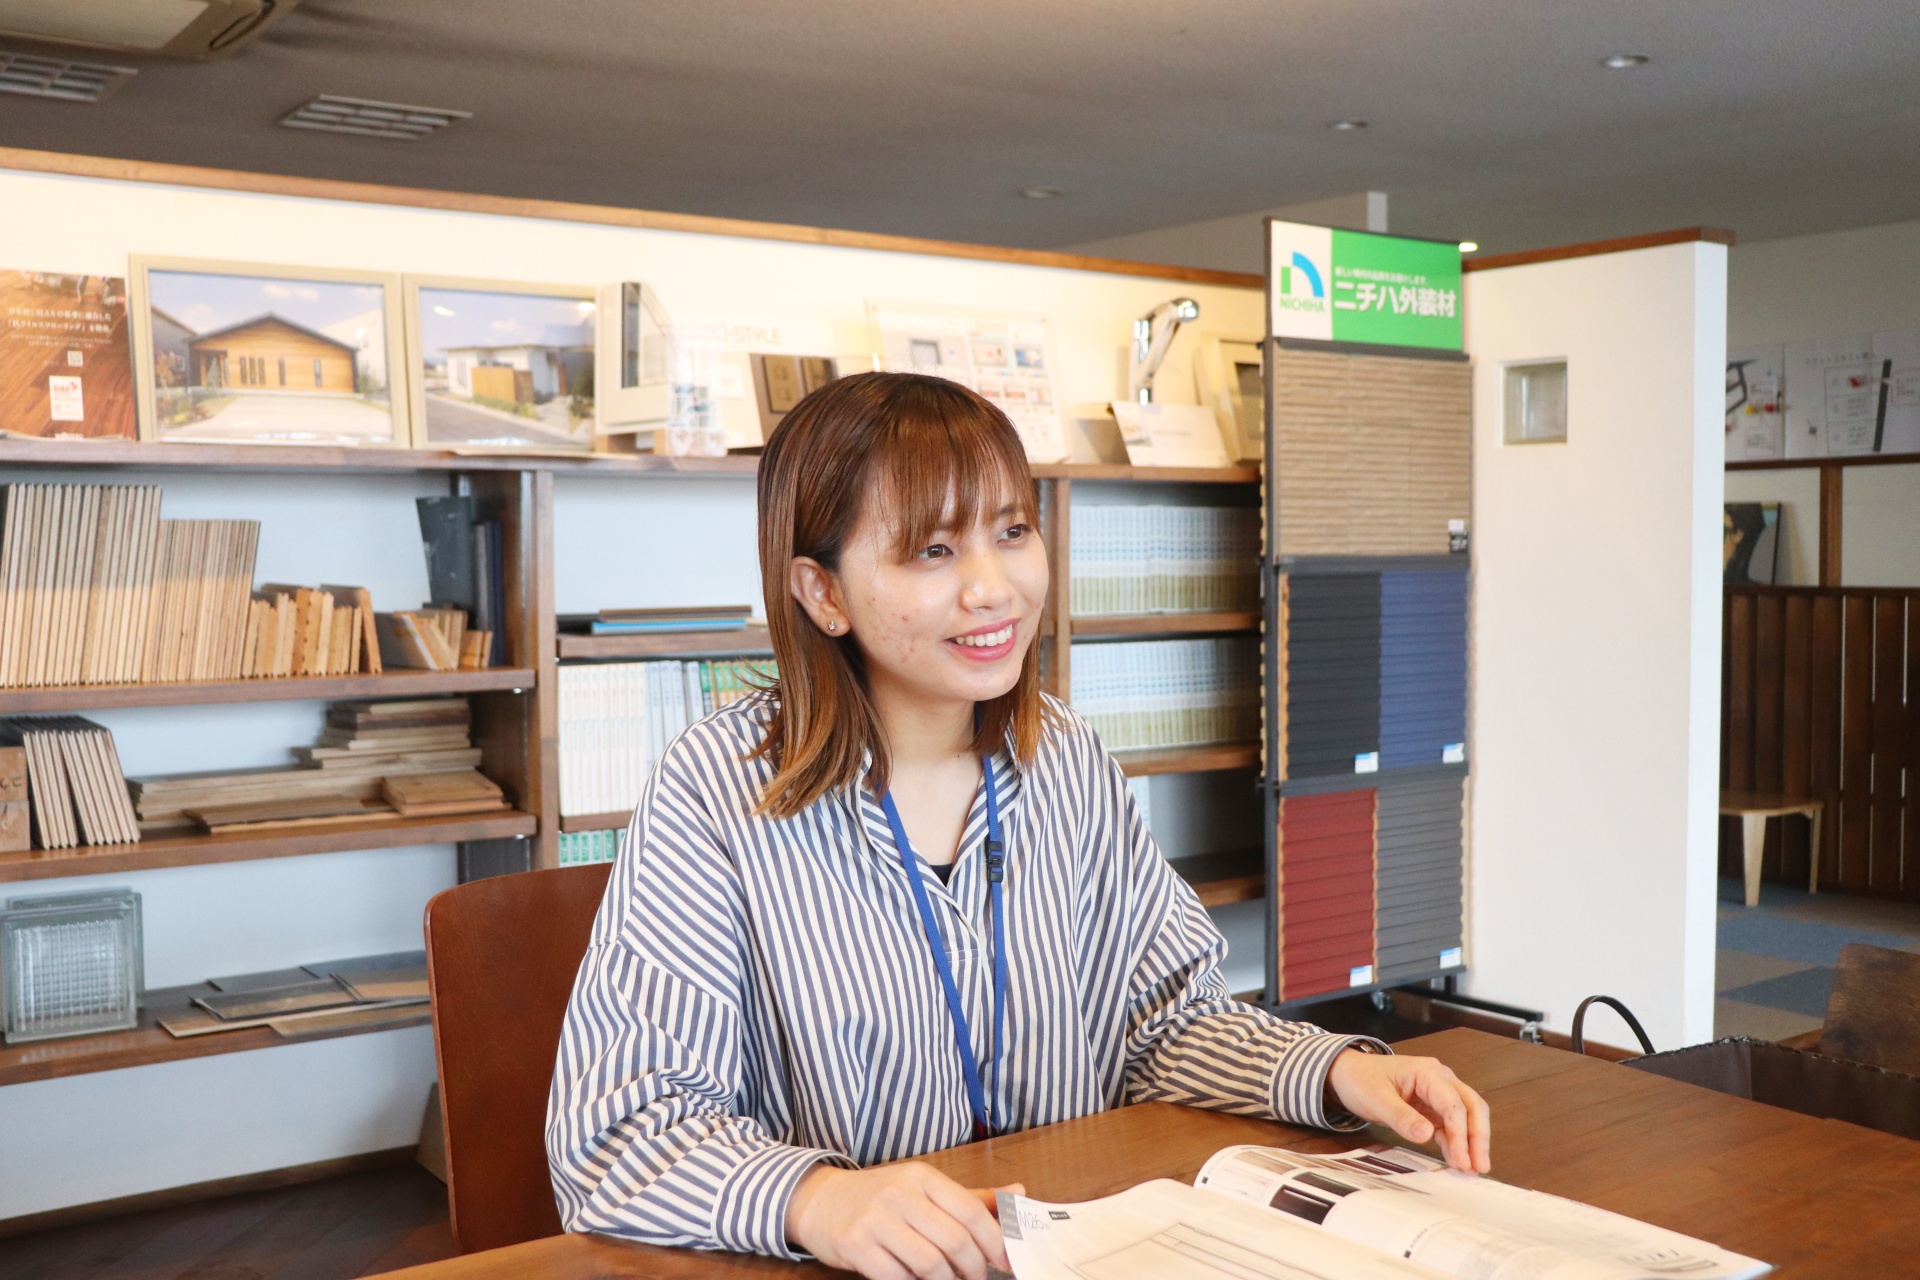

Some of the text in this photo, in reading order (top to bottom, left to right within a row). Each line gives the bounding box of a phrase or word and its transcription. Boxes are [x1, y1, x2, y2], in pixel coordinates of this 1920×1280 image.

[1280, 297, 1325, 313] NICHIHA
[1334, 281, 1457, 318] ニチハ外装材
